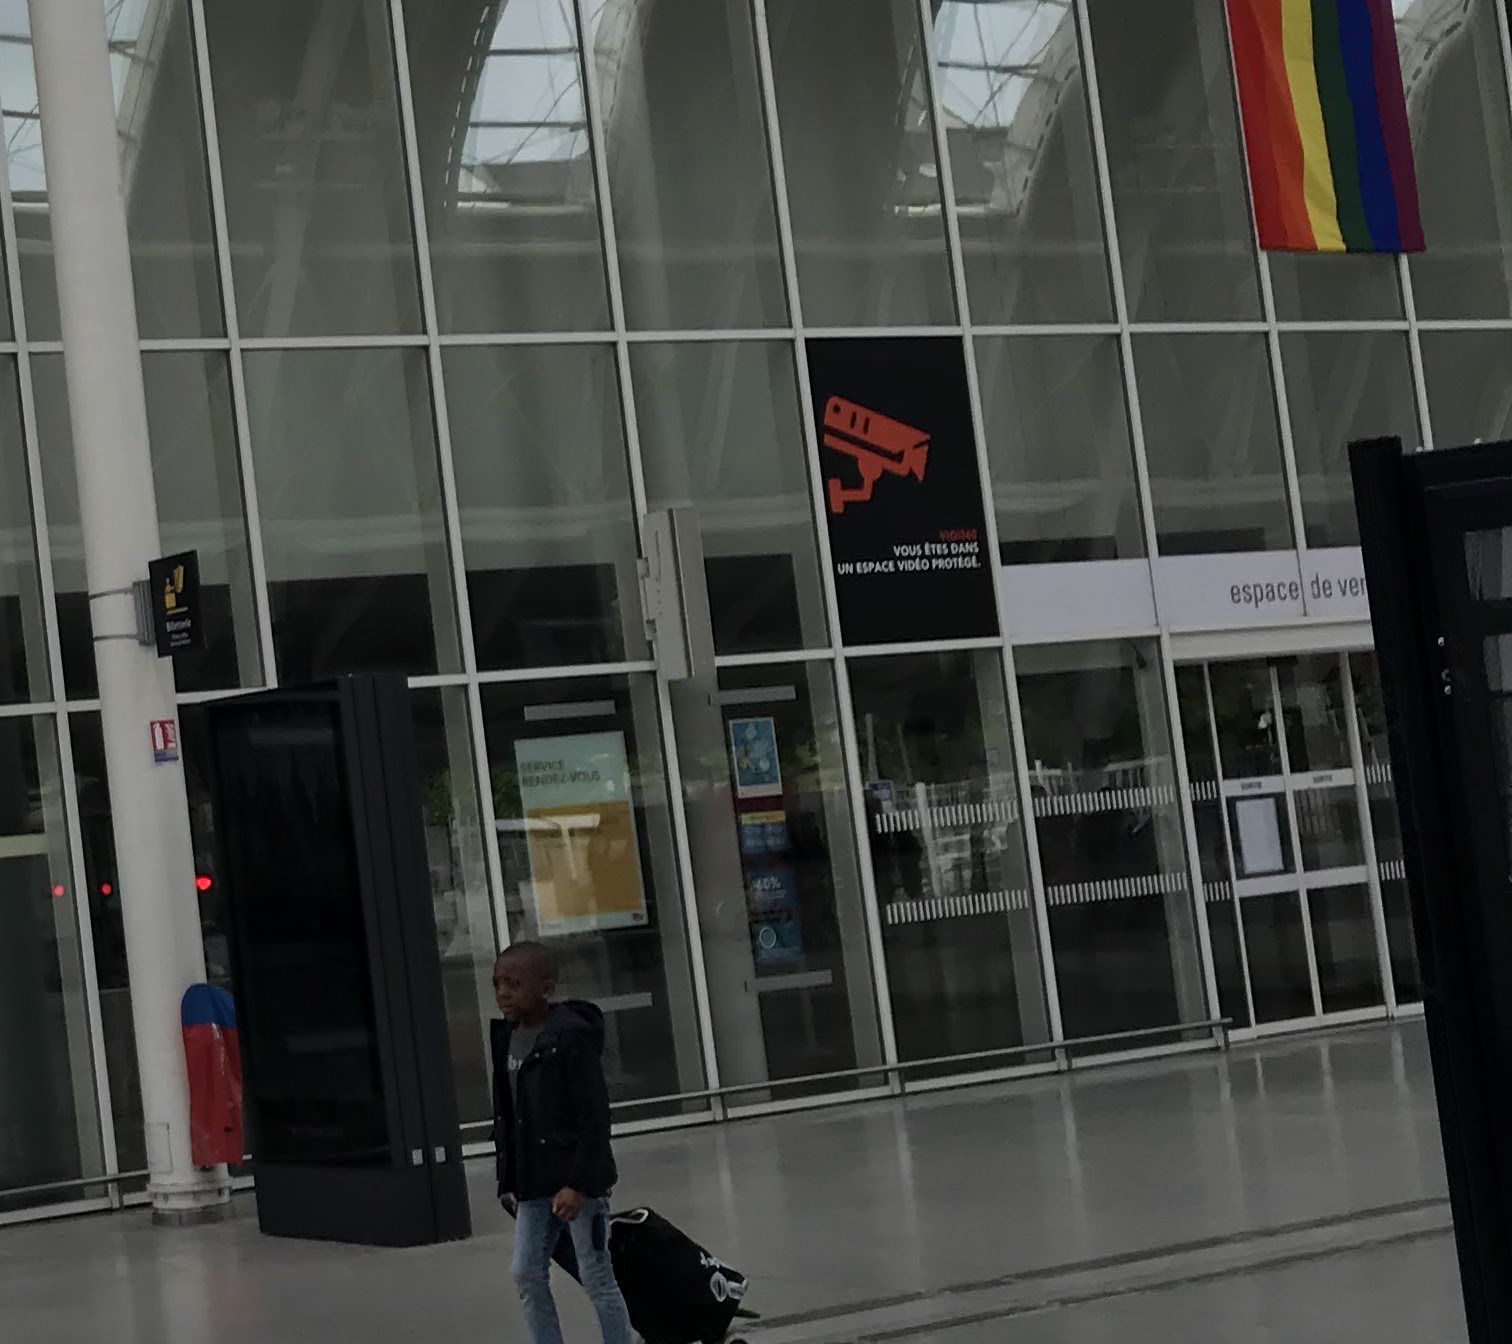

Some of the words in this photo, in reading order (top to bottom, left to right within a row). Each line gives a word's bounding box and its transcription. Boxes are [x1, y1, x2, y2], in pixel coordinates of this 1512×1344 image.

[893, 544, 922, 557] VOUS
[924, 541, 948, 556] ÊTES
[950, 541, 980, 554] DANS
[837, 562, 854, 575] UN
[856, 559, 895, 574] ESPACE
[897, 556, 930, 572] VIDÉO
[1230, 580, 1300, 608] espace
[1310, 572, 1333, 600] de
